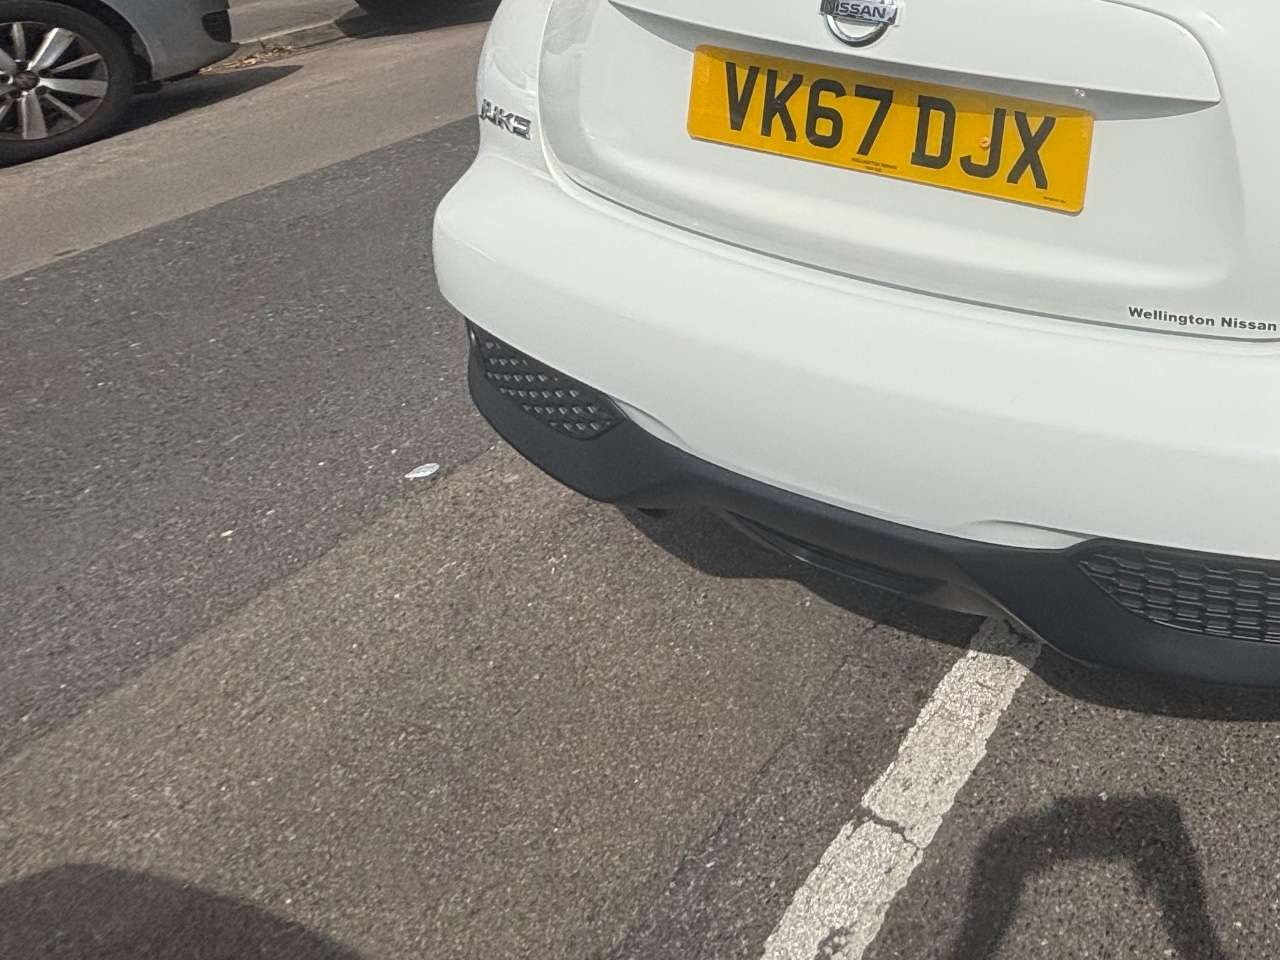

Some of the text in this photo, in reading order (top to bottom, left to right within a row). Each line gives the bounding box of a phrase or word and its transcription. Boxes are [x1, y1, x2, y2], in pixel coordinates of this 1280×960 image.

[480, 98, 532, 140] JUKE
[725, 61, 1056, 191] VK67 DJX
[1128, 306, 1278, 332] Wellington Nissan
